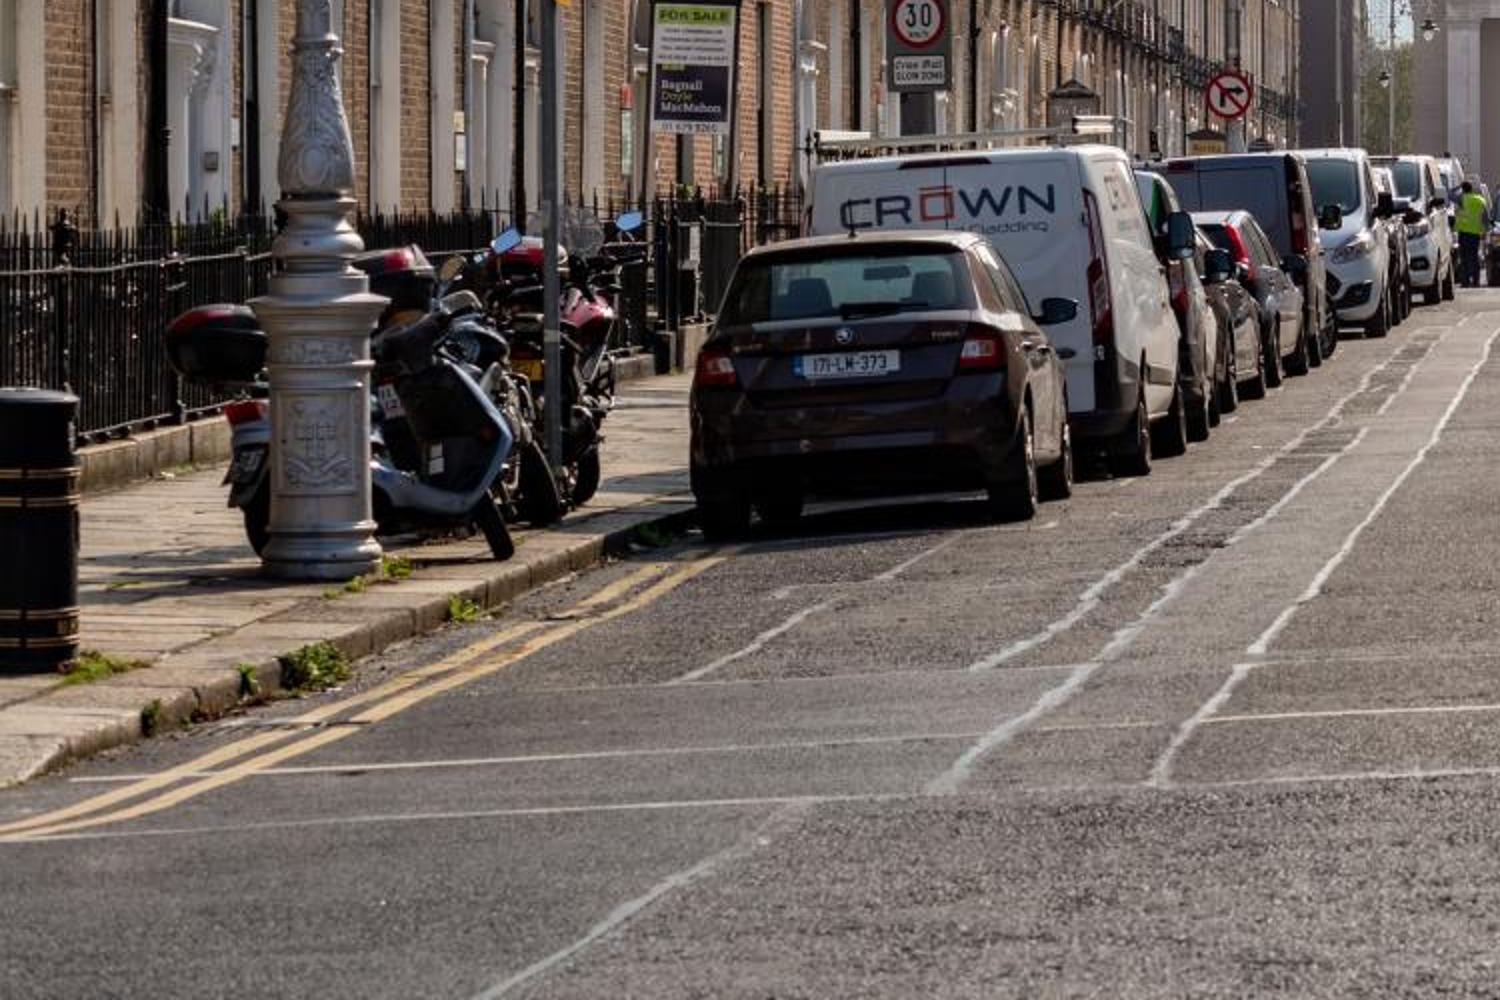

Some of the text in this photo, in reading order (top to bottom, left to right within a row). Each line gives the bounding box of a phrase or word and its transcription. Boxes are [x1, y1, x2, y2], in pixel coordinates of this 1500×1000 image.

[660, 9, 728, 21] FOR SALE
[905, 3, 931, 27] 30
[896, 71, 942, 80] SLOW ZONE
[661, 79, 703, 93] Bagnall
[661, 91, 692, 103] Doyle
[661, 101, 721, 113] MacMahon
[840, 184, 1055, 230] CROWN
